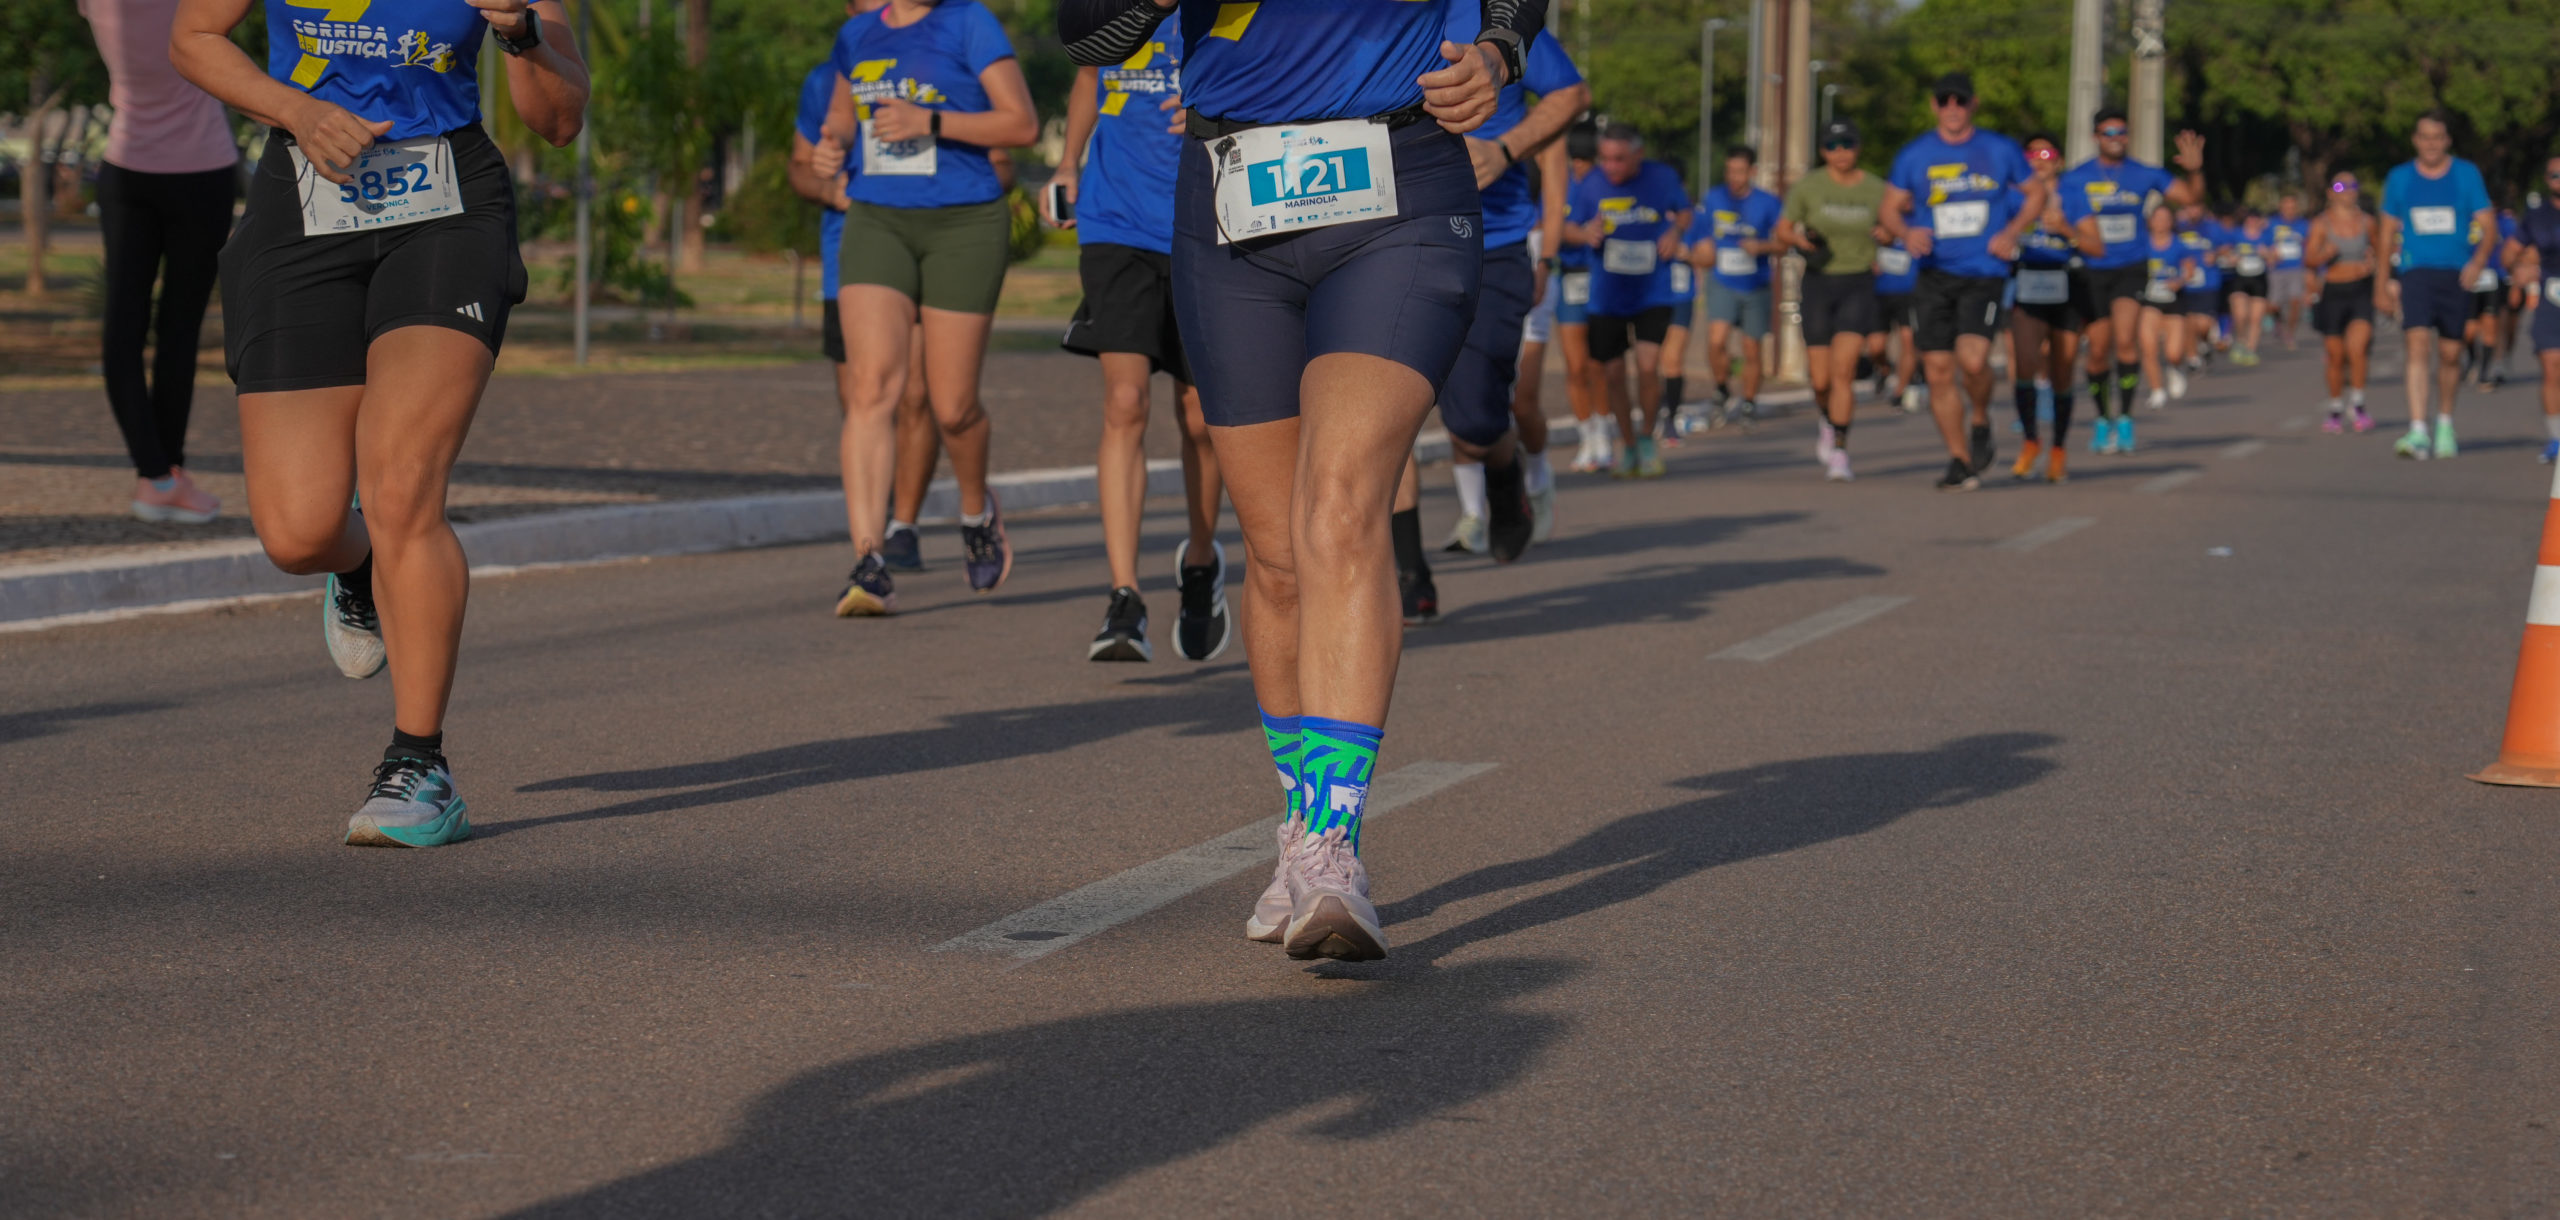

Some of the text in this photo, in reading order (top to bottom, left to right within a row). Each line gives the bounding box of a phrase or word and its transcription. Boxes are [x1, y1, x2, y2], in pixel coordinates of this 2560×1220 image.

[293, 19, 388, 41] CORRIDA
[314, 38, 388, 59] JUSTIÇA
[340, 162, 433, 203] 5852
[1266, 156, 1346, 198] 1121
[1285, 195, 1338, 209] MARINOLIA
